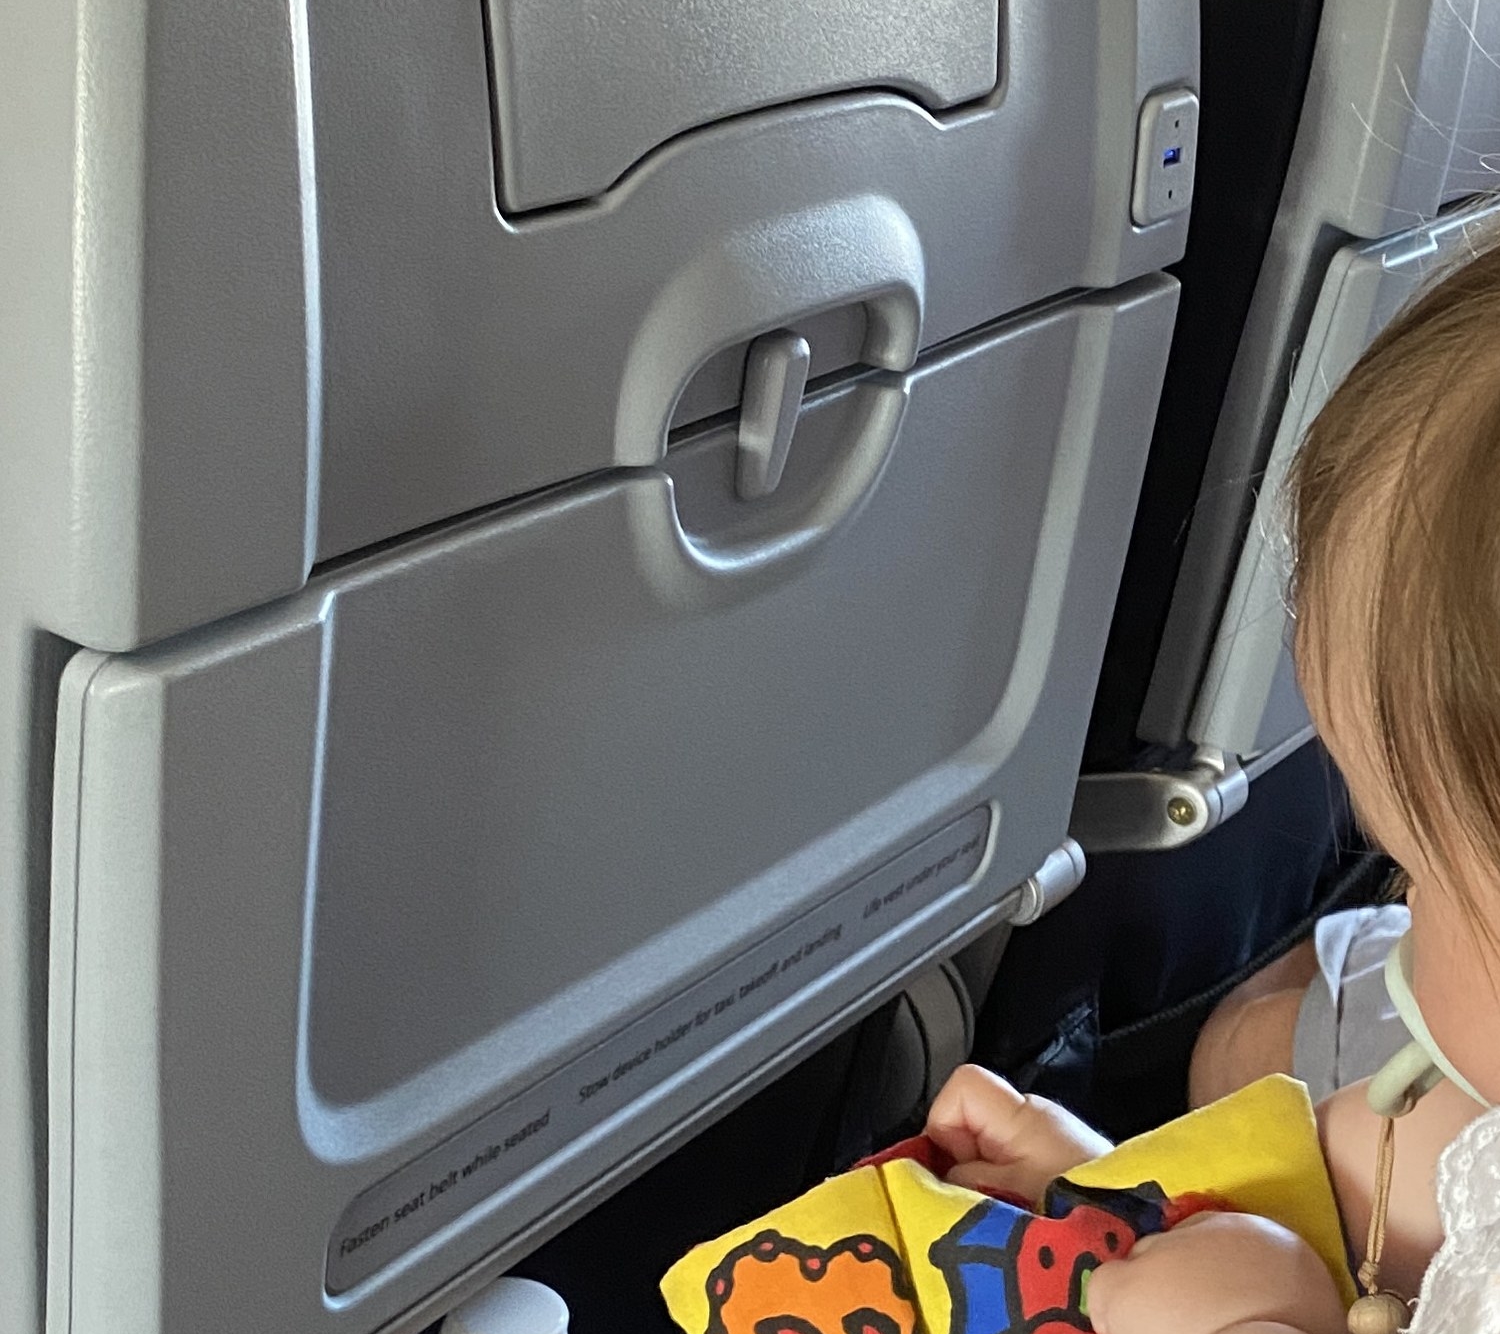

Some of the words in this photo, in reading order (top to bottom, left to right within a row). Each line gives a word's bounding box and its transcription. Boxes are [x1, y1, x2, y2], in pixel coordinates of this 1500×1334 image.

[579, 1072, 612, 1103] Stow
[612, 1047, 653, 1082] device
[655, 1021, 694, 1053] holder
[694, 1009, 712, 1029] for
[781, 948, 803, 972] and
[340, 1215, 391, 1259] Fasten
[394, 1191, 426, 1223] seat
[428, 1170, 461, 1202] belt
[461, 1145, 502, 1180] while
[504, 1107, 551, 1153] seated
